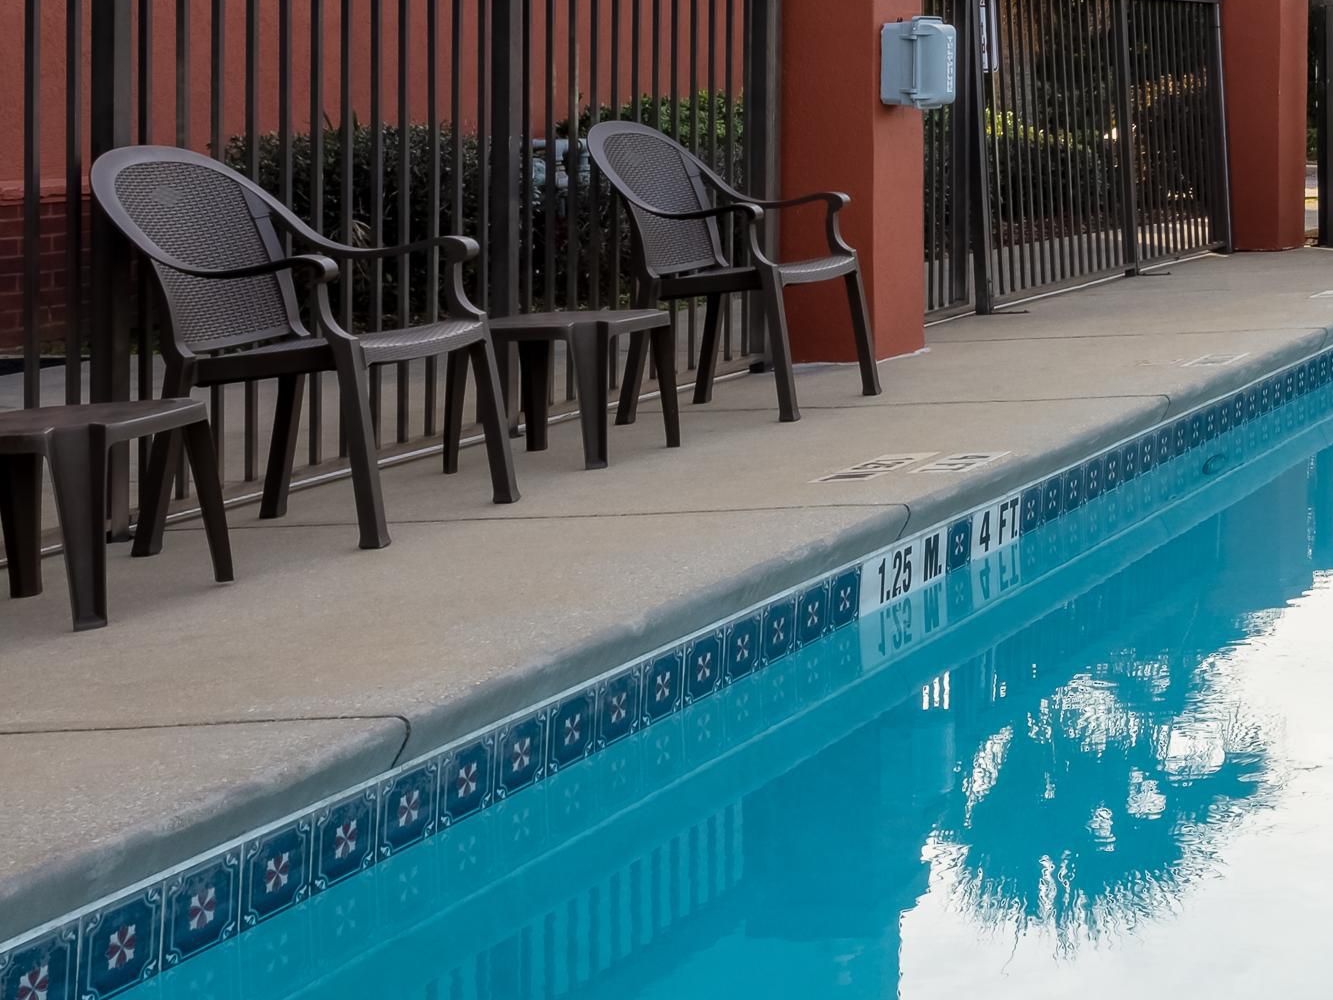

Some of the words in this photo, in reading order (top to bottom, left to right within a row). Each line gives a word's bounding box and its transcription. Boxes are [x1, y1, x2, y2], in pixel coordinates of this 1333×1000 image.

[979, 510, 991, 552] 4
[998, 497, 1021, 545] FT.
[878, 546, 912, 604] 1.25
[923, 533, 942, 582] M.
